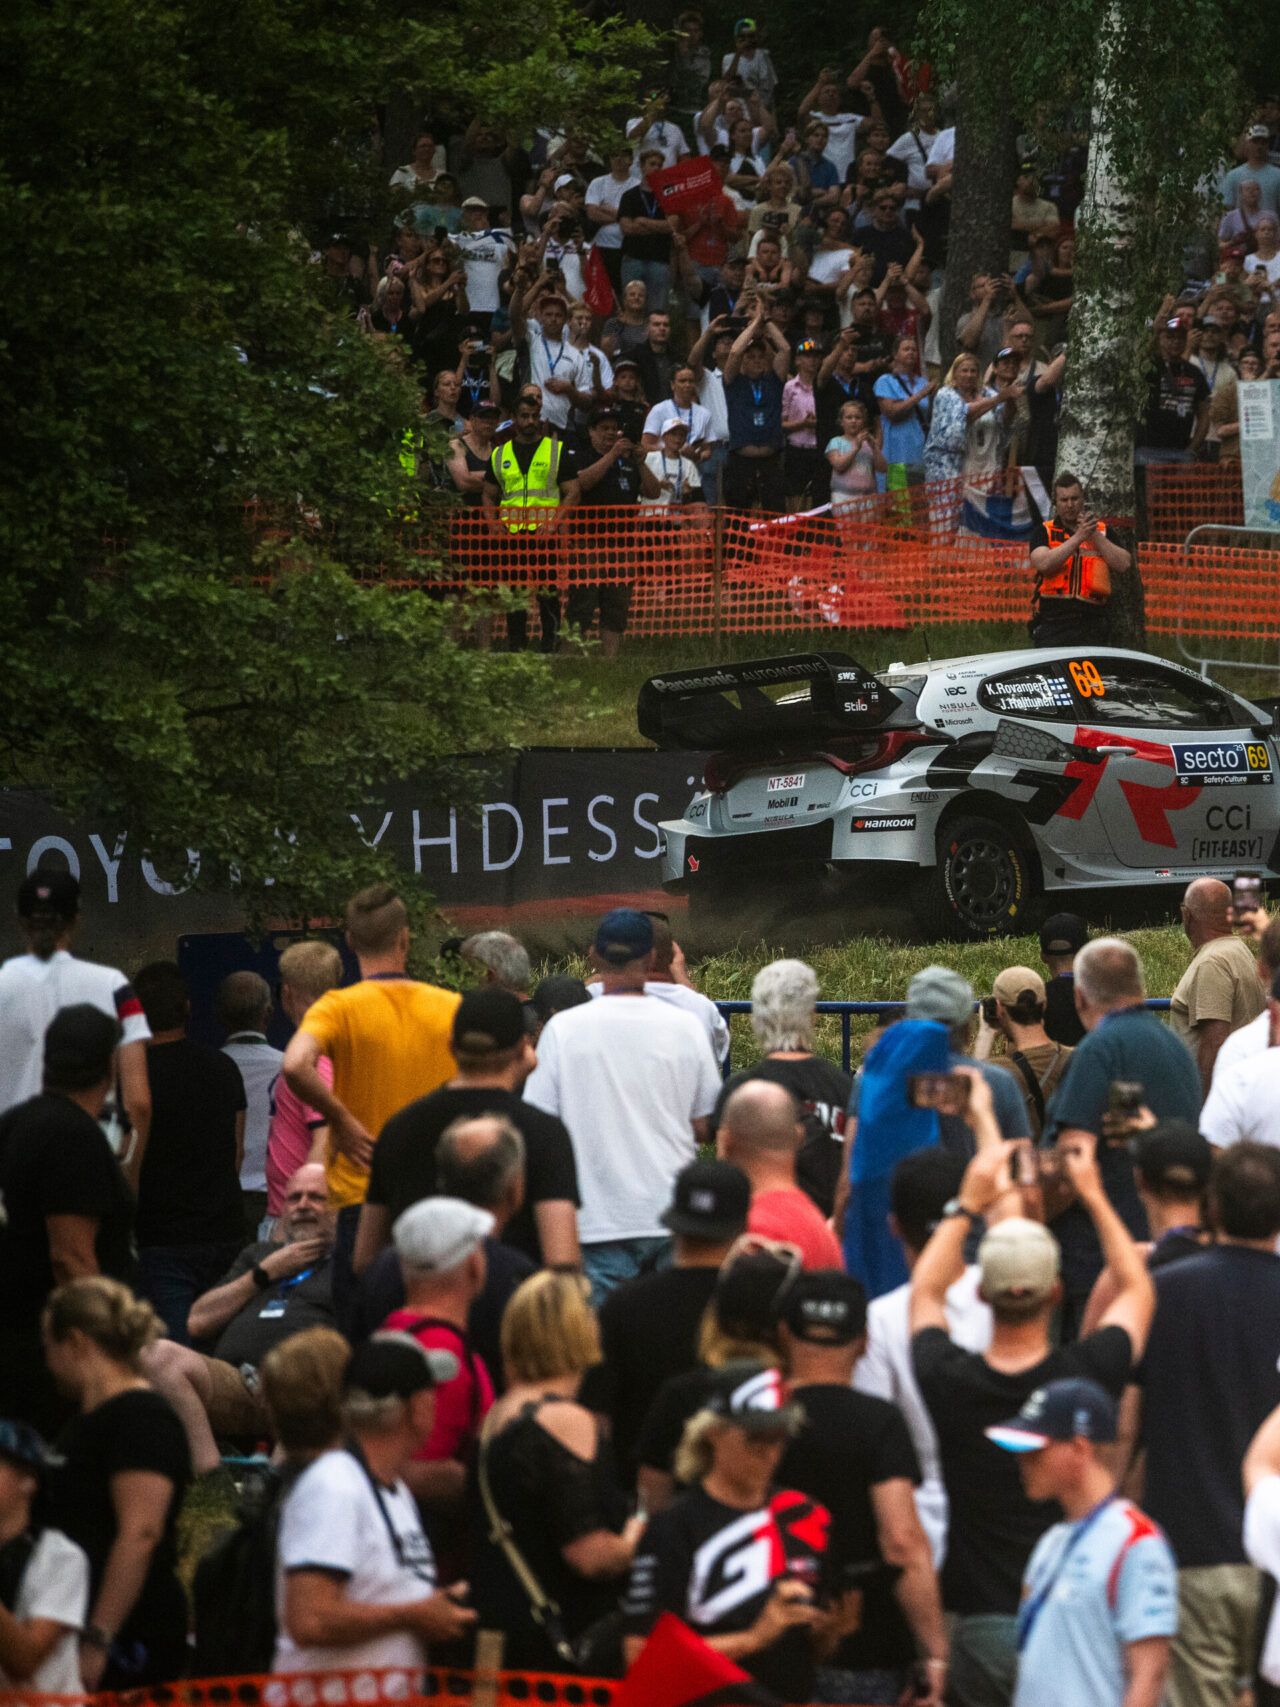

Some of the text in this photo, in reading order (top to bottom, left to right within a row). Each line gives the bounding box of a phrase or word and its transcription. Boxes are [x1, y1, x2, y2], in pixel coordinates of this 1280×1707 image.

[651, 661, 828, 692] Panasonic AUTOMOTIVE
[1068, 660, 1105, 697] 69
[844, 698, 868, 711] Stilo
[939, 702, 977, 710] NISULA
[945, 717, 974, 726] Microsoft
[1183, 747, 1239, 769] secto
[1247, 745, 1269, 769] 69
[768, 776, 803, 790] NT-5841
[1203, 776, 1247, 785] SafetyCulture
[768, 798, 789, 809] Mobil
